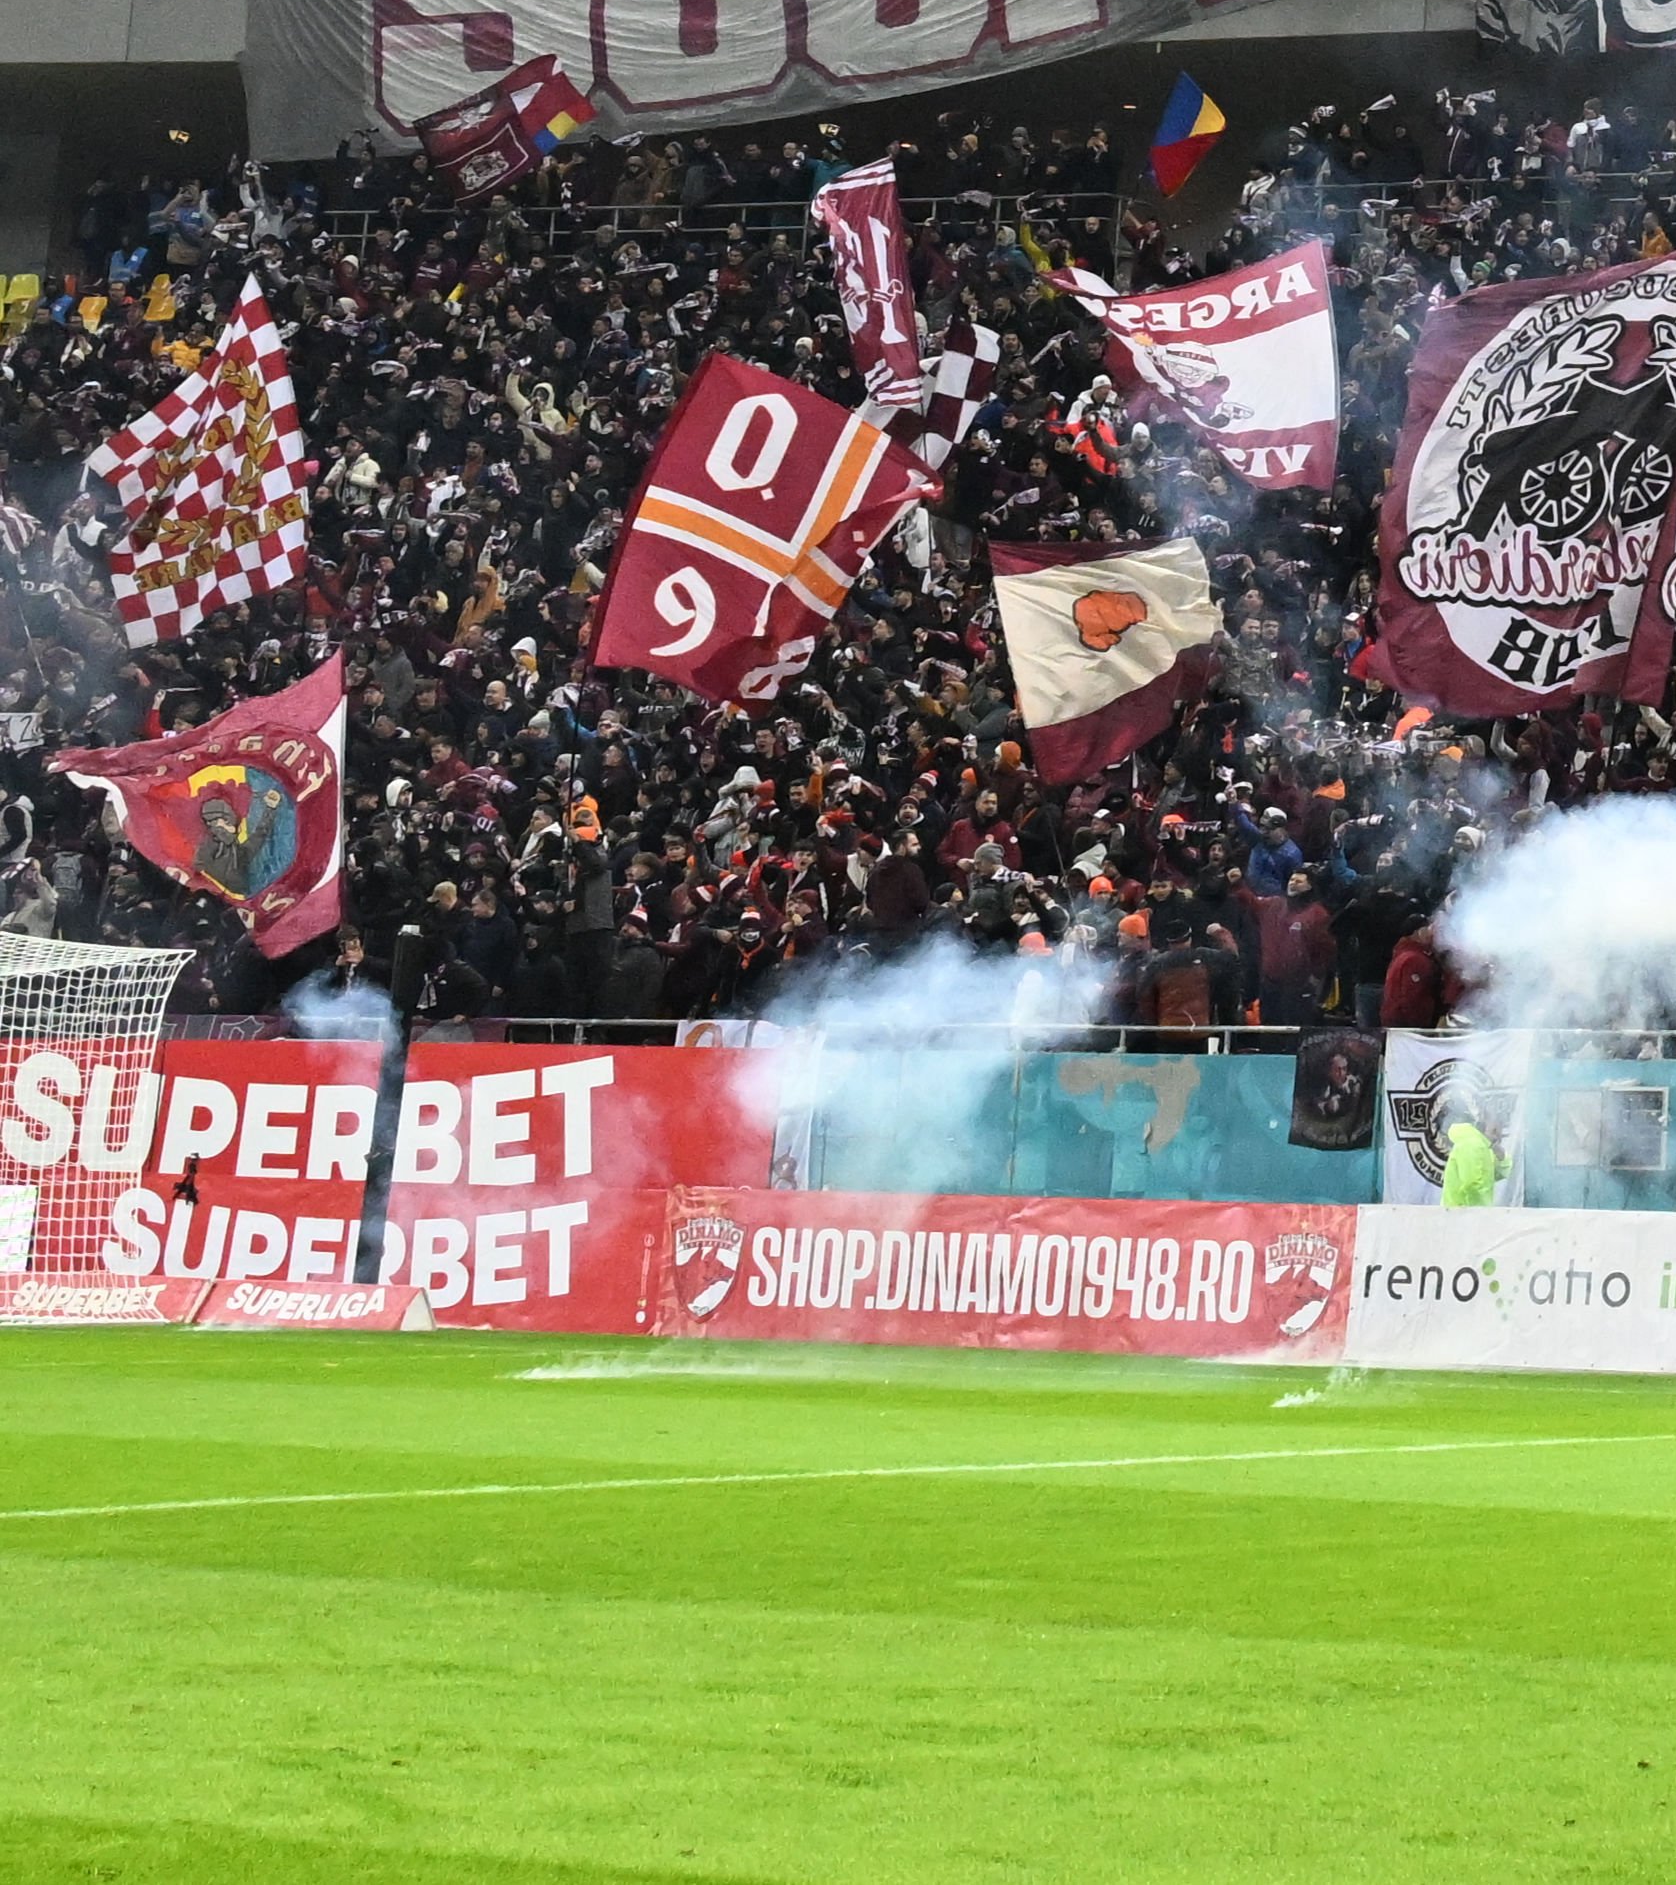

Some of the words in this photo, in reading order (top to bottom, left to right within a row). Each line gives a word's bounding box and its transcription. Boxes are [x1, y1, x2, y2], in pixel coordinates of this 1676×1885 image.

[2, 1051, 614, 1187] SUPERBET
[678, 1226, 741, 1246] DINAMO
[1267, 1241, 1336, 1264] DINAMO
[747, 1226, 1255, 1325] SHOP.DINAMO1948.RO
[226, 1281, 386, 1322] SUPERLIGA
